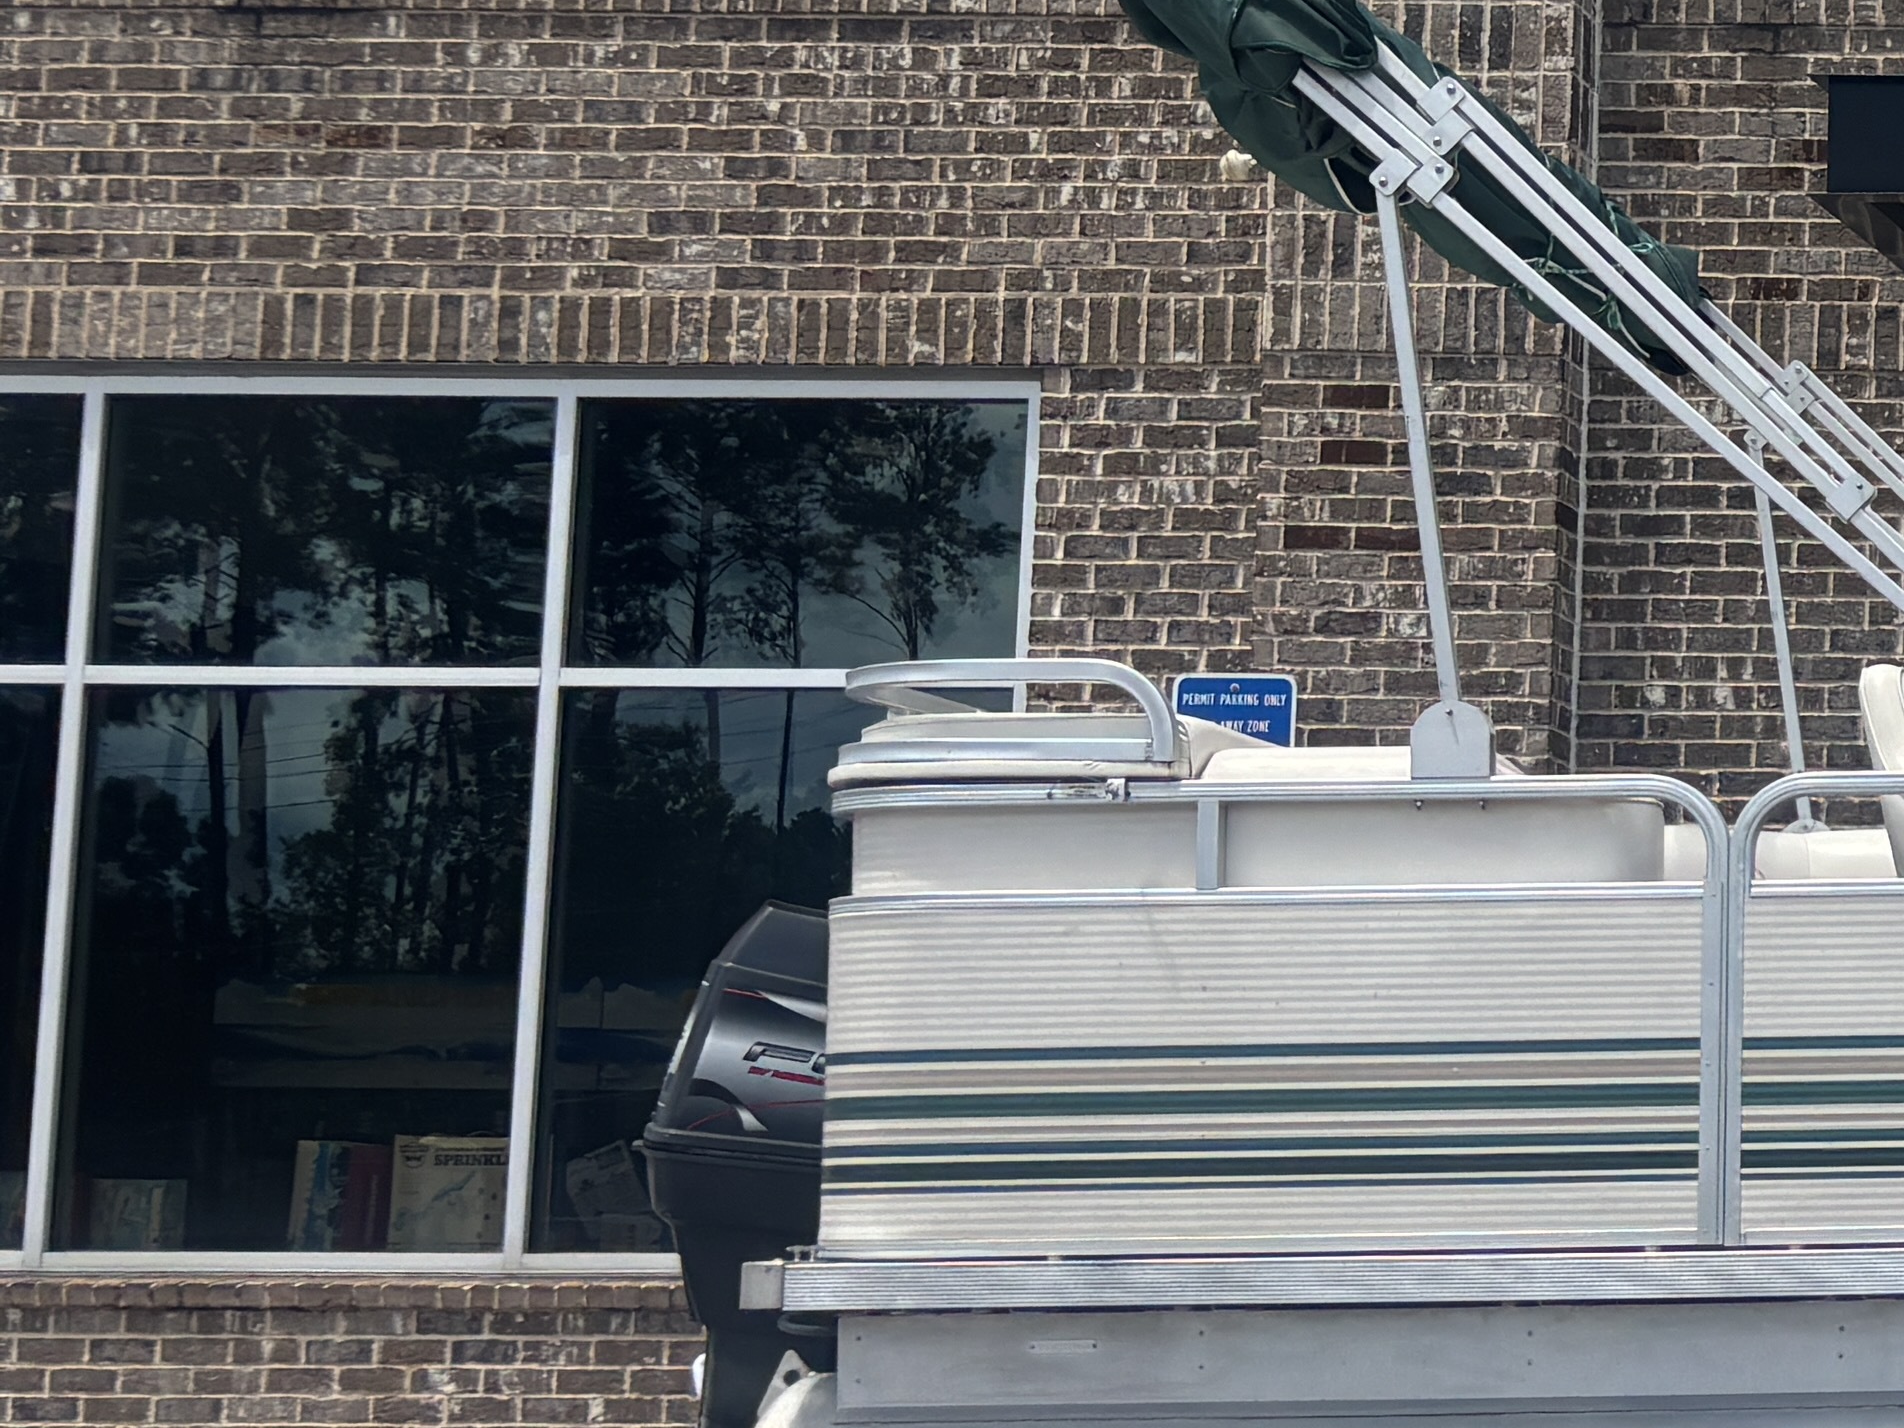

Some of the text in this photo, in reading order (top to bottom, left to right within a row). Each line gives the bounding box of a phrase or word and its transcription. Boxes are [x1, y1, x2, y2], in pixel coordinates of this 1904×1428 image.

[1182, 693, 1287, 707] PERMIT PARKING ONLY
[1246, 719, 1271, 733] ZONE
[433, 1154, 506, 1166] SPRINKL
